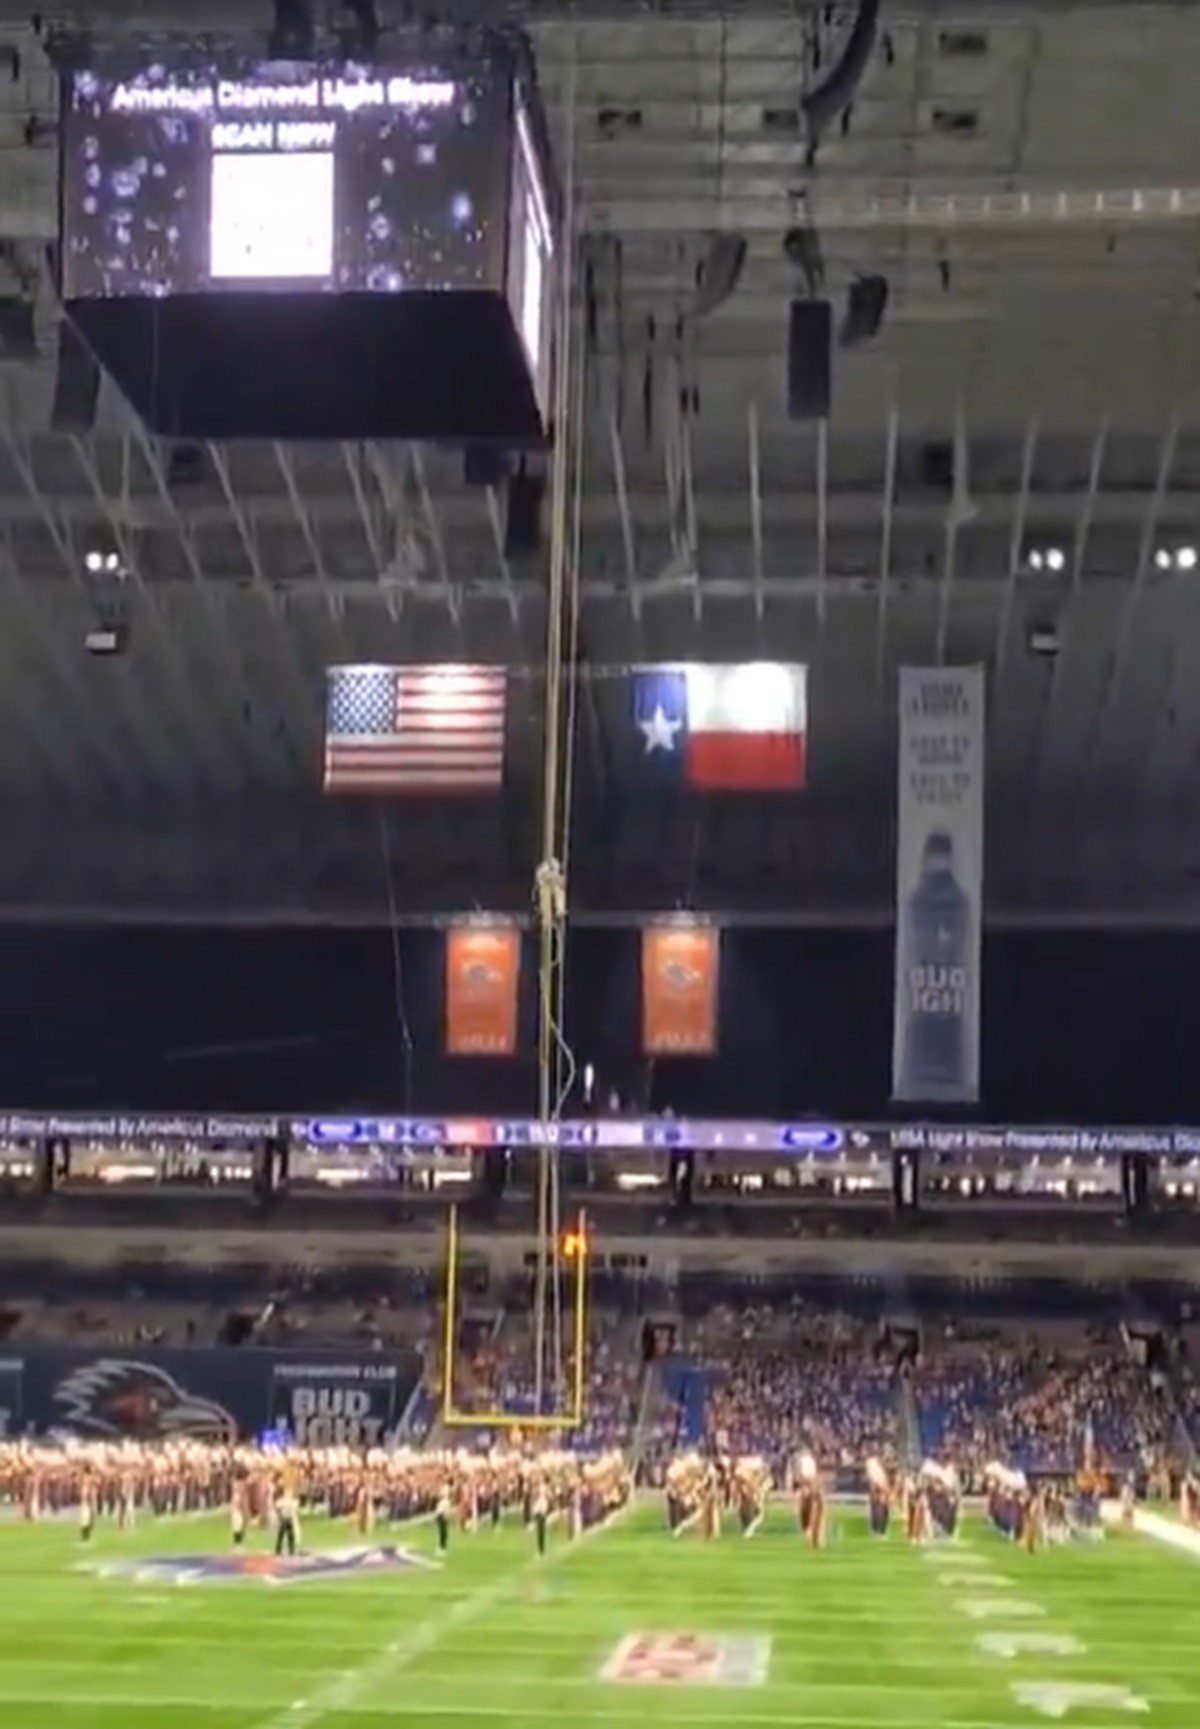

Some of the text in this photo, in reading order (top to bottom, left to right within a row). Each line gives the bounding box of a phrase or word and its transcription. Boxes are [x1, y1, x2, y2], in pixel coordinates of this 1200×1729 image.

[218, 81, 318, 106] Diamond
[323, 79, 383, 109] Light
[388, 78, 454, 106] Show
[212, 122, 273, 147] SCAN
[909, 964, 966, 990] BUD
[291, 1386, 371, 1418] BUD
